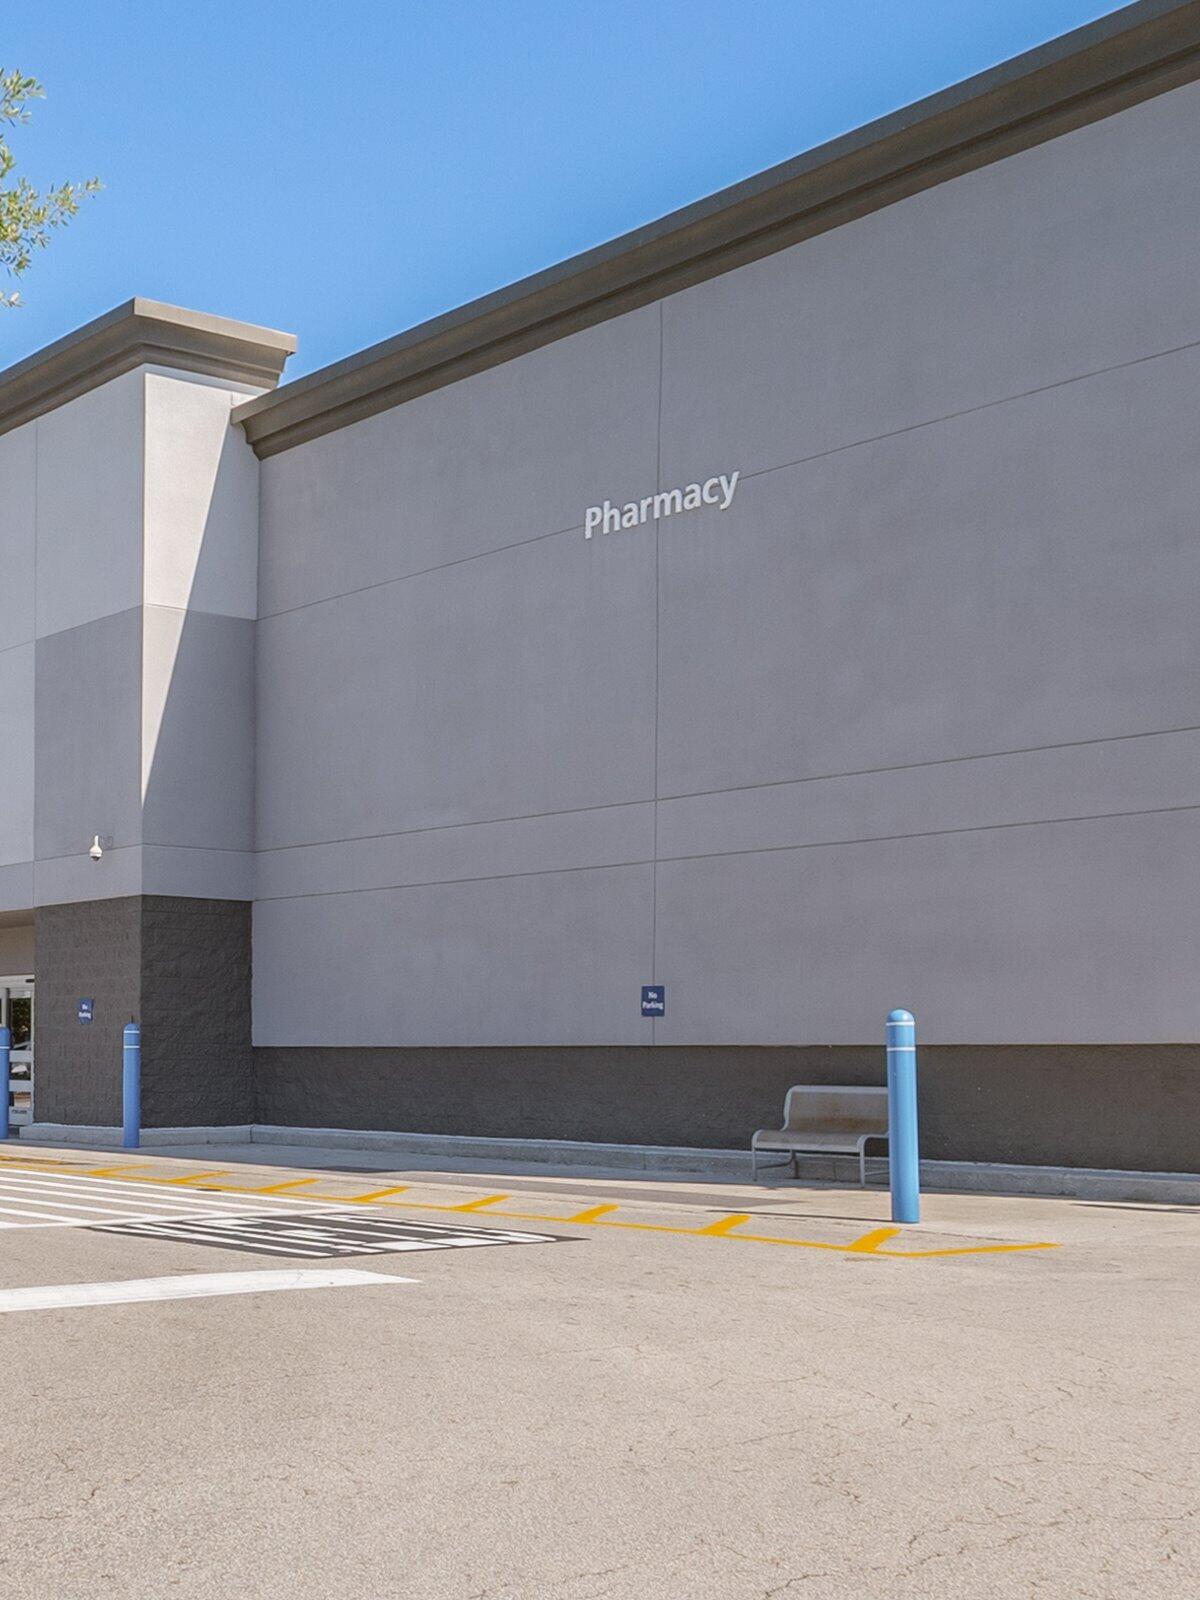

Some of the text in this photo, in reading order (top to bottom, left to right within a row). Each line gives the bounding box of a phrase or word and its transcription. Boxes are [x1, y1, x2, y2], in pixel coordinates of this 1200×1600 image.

[584, 471, 740, 540] Pharmacy
[642, 1001, 663, 1010] Parking
[648, 991, 658, 999] No
[90, 1214, 556, 1257] YIELD
